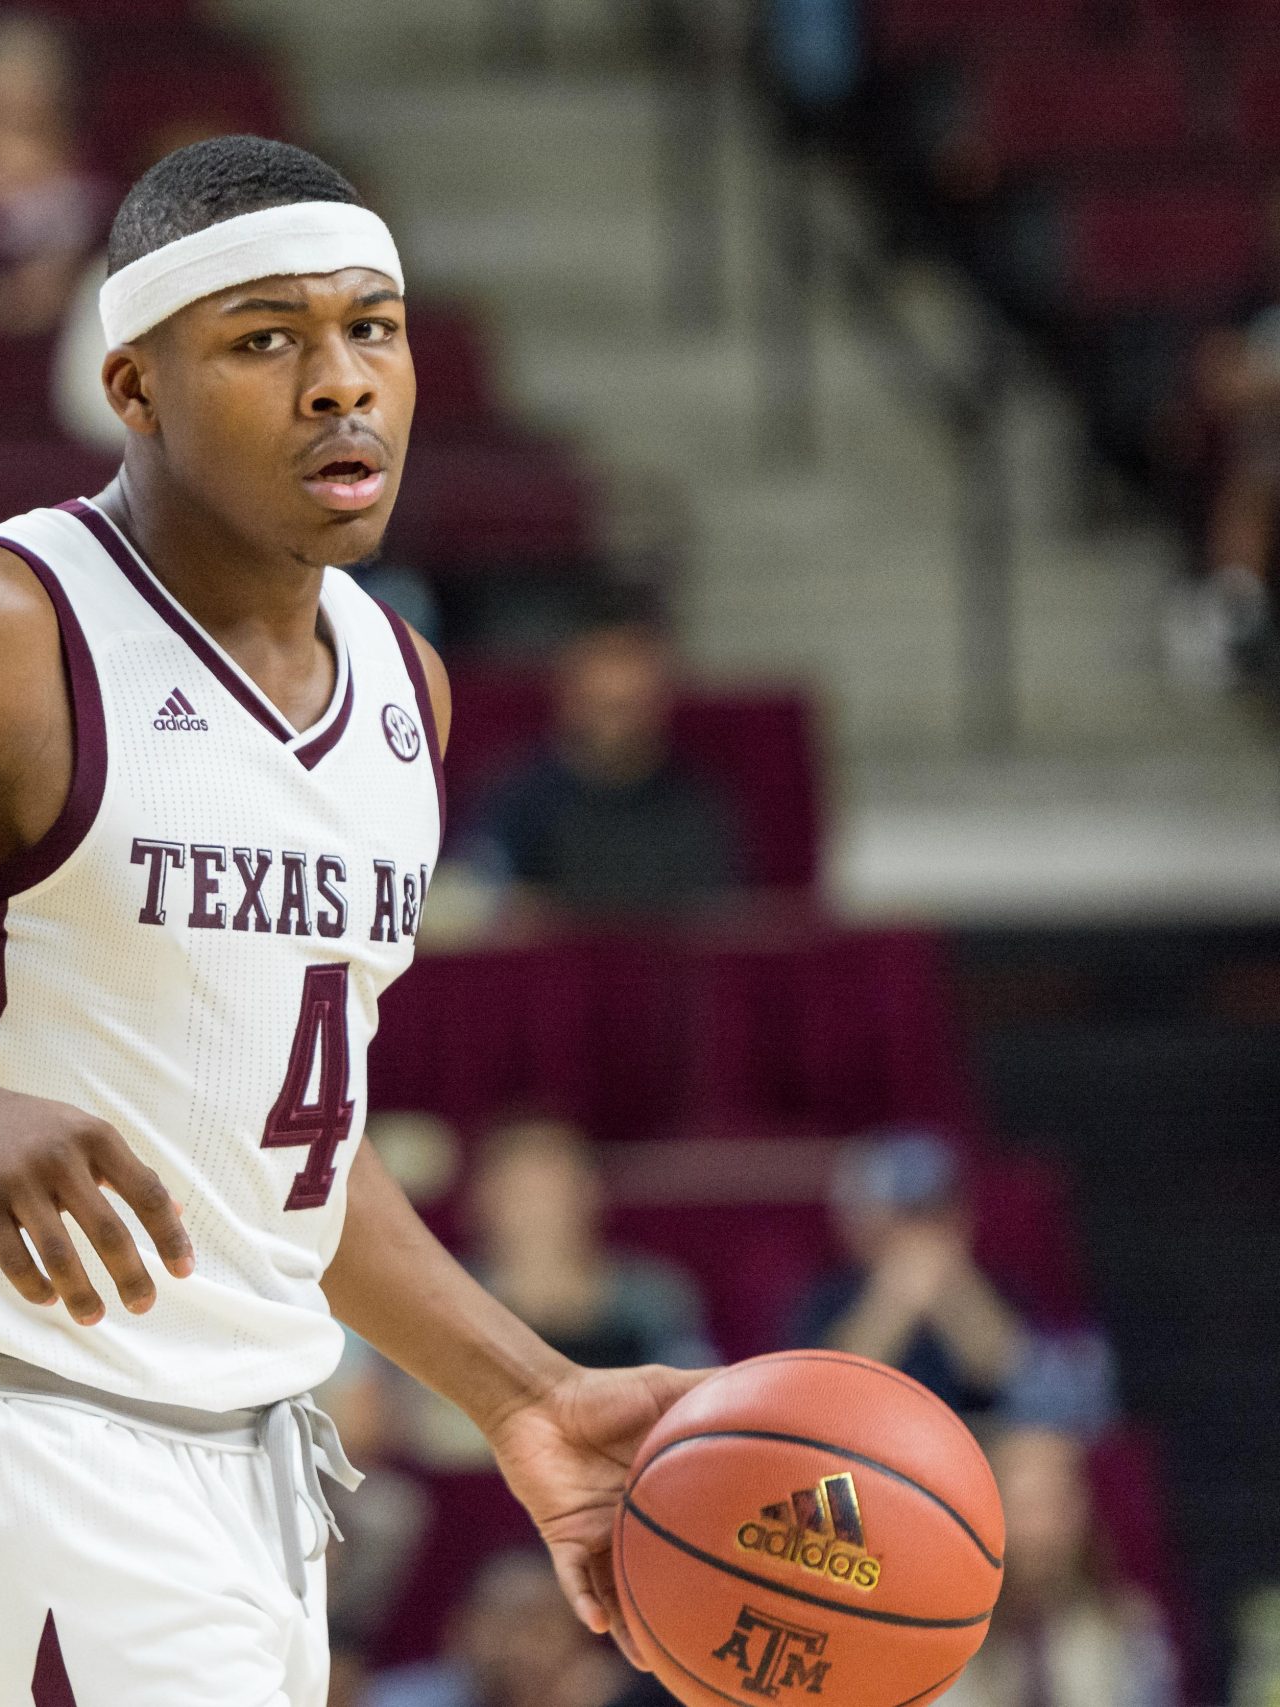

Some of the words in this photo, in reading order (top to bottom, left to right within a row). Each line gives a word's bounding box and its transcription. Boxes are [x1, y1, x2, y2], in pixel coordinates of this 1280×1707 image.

[153, 715, 209, 731] adidas
[382, 704, 421, 762] SEC
[130, 837, 349, 938] TEXAS
[260, 961, 356, 1212] 4
[736, 1520, 882, 1591] adidas
